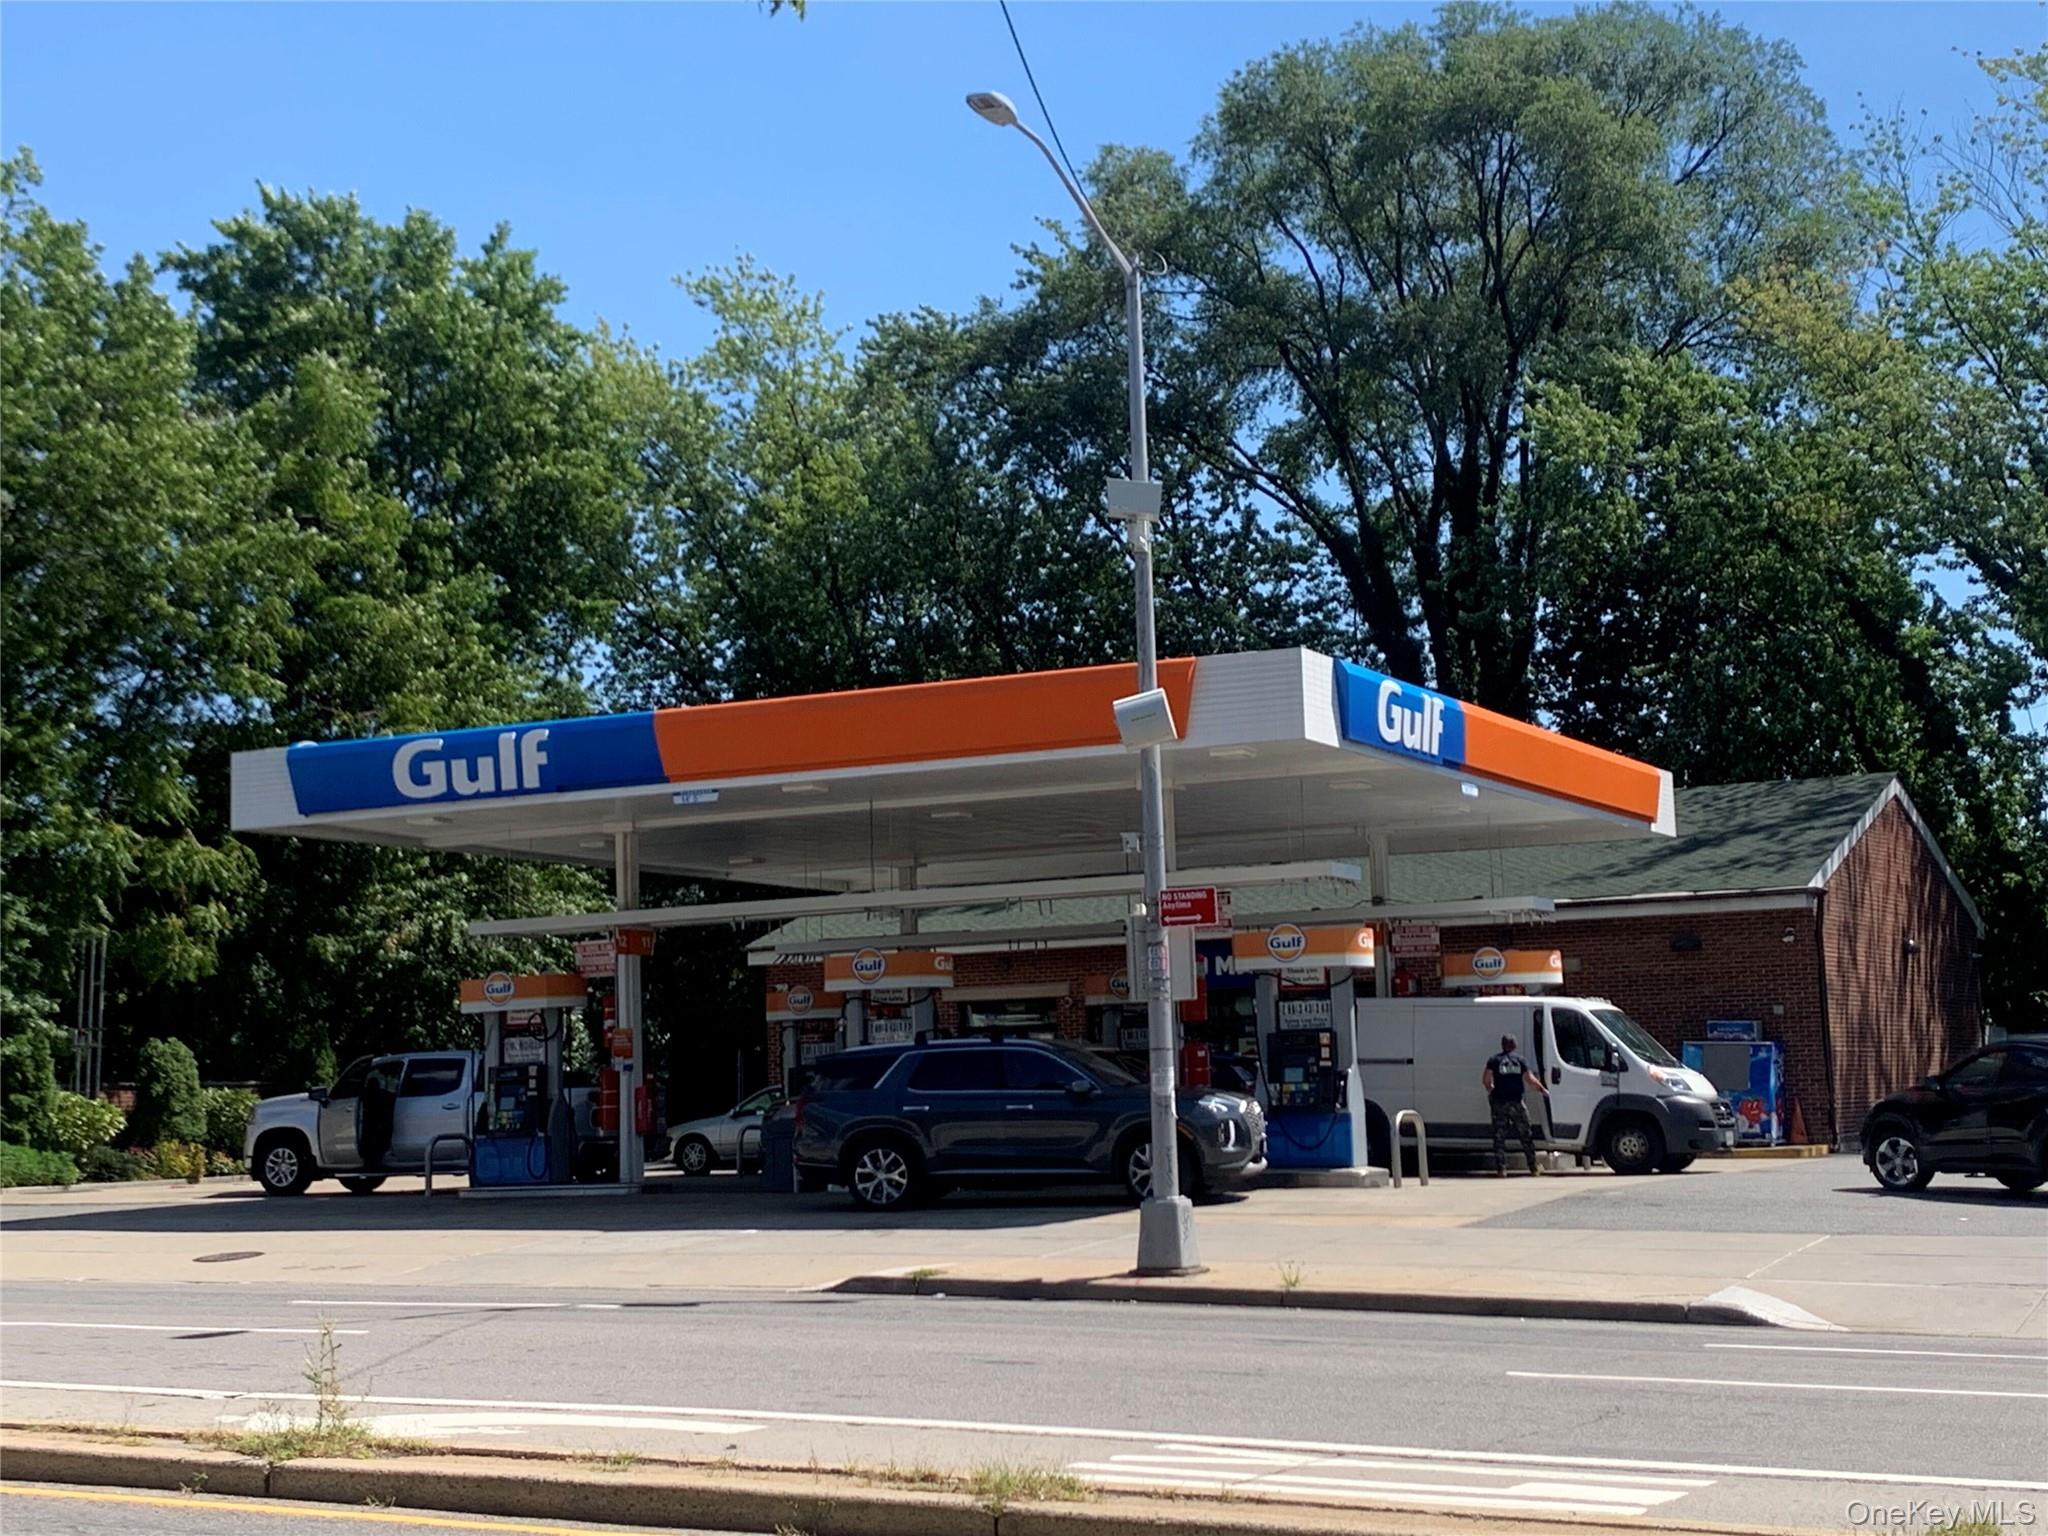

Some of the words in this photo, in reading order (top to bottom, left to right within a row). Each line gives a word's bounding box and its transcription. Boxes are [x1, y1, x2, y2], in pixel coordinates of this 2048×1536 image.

[1378, 679, 1444, 756] Gulf
[392, 728, 549, 800] Gulf
[1162, 892, 1172, 902] NO
[1173, 890, 1207, 901] STANDING
[1162, 901, 1192, 911] Anytime
[1270, 935, 1303, 949] Gulf
[854, 959, 882, 971] Gulf
[1474, 957, 1502, 969] Gulf
[486, 982, 512, 994] Gulf
[789, 995, 811, 1005] Gulf
